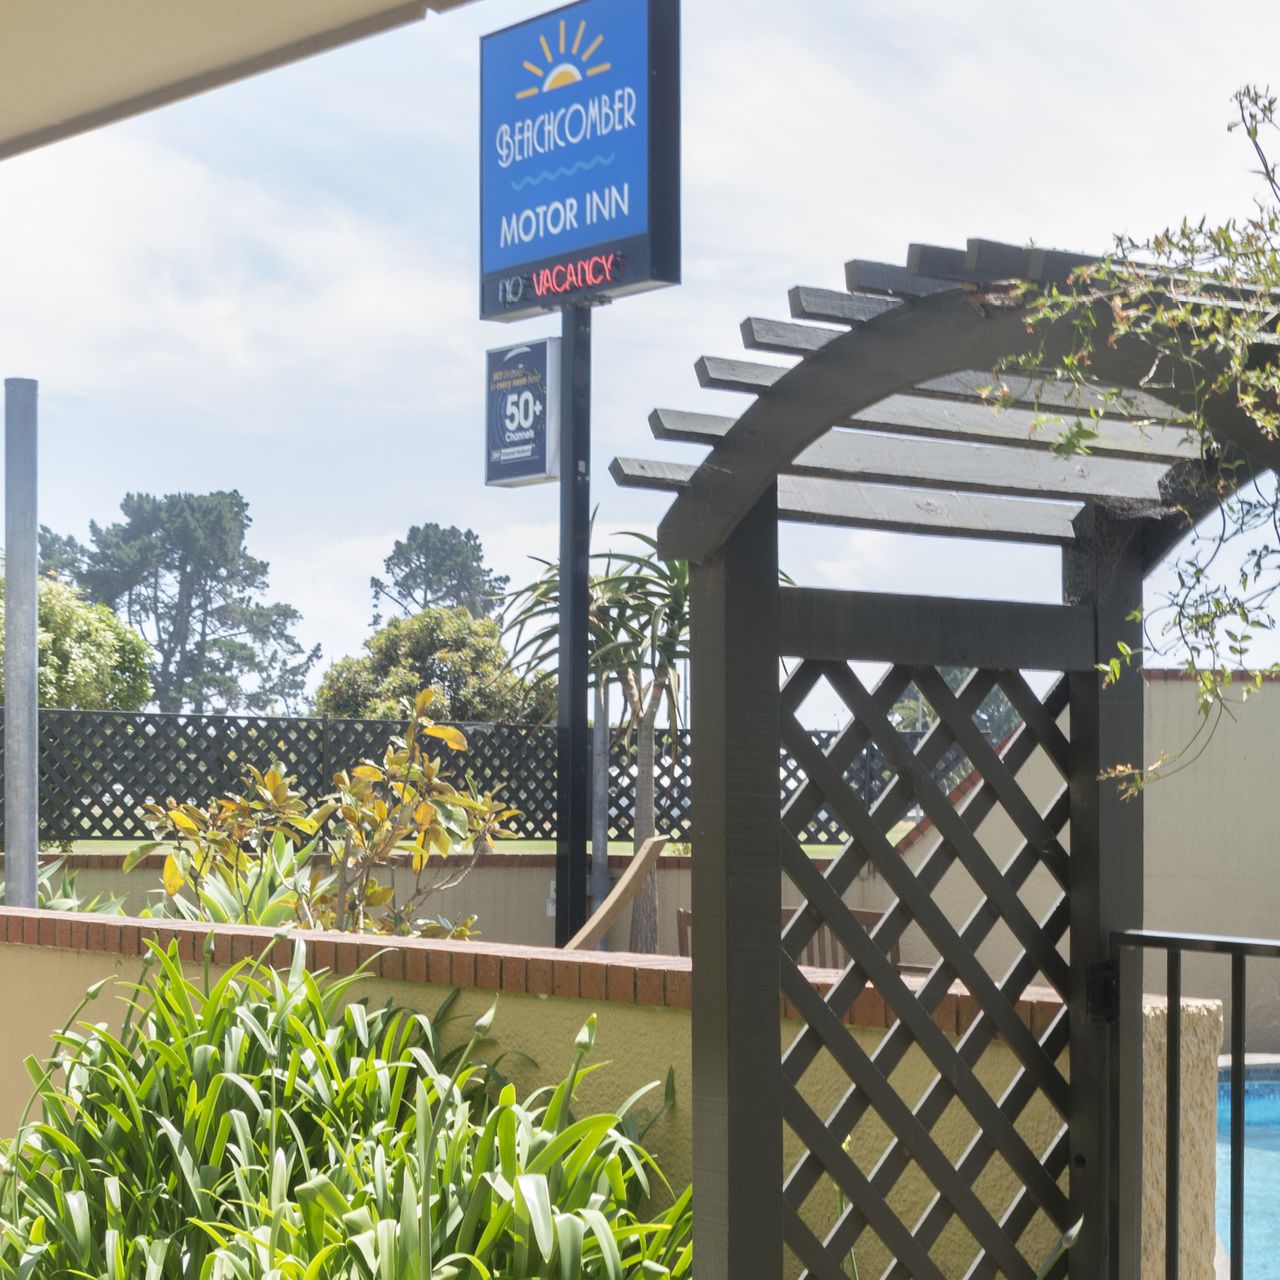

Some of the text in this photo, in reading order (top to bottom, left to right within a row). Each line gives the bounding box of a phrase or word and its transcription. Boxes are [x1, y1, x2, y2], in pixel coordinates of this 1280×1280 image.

[496, 87, 636, 168] BEACHCOMBER
[500, 183, 629, 248] MOTOR INN
[532, 254, 615, 296] VACANCY
[505, 429, 535, 442] Channels
